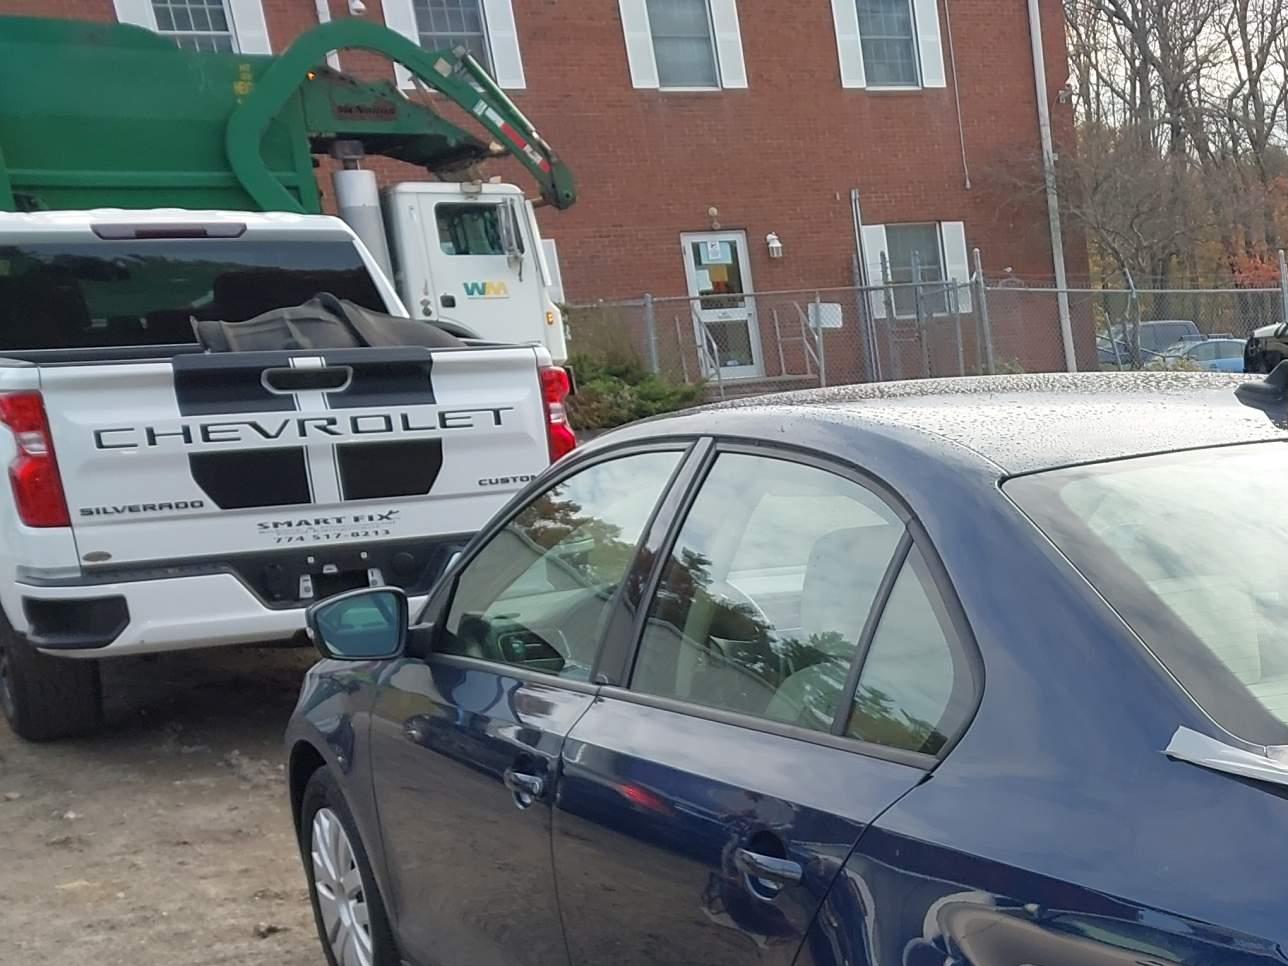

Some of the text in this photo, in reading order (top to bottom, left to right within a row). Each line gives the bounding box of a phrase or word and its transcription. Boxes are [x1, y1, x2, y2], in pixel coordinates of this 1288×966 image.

[462, 281, 509, 297] WM
[92, 406, 515, 450] CHEVROLET
[79, 499, 205, 516] SILVERADO
[256, 515, 346, 530] SMART
[352, 510, 398, 523] FIX
[274, 534, 306, 544] 774
